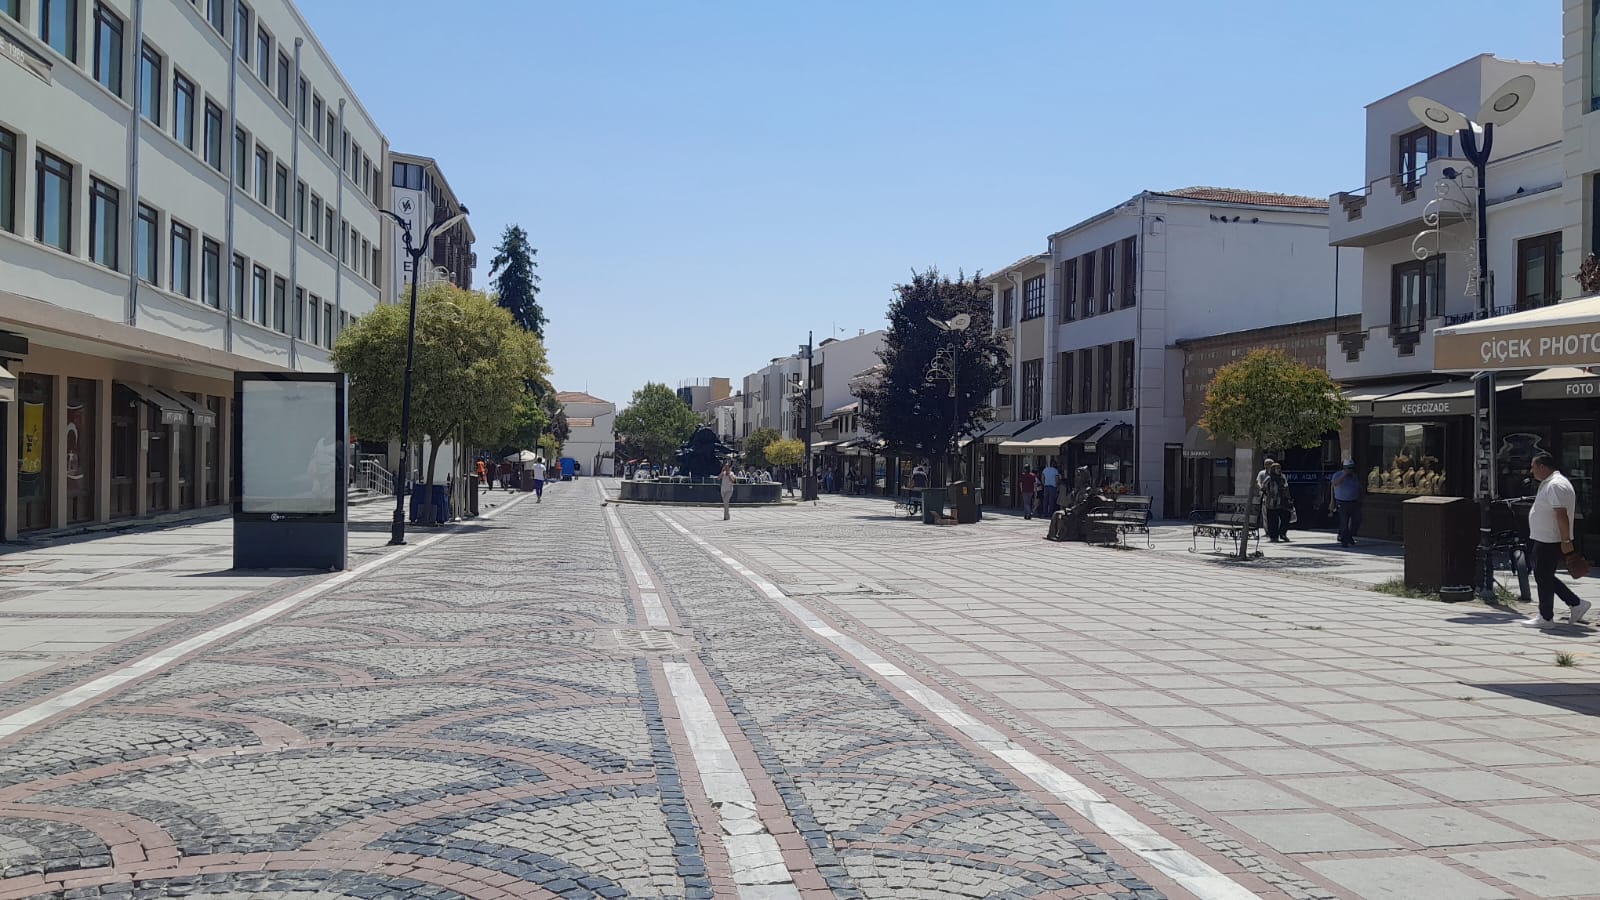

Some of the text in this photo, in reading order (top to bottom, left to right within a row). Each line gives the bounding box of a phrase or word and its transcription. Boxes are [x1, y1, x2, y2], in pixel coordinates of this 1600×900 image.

[1480, 336, 1532, 363] ÇİÇEK
[1566, 383, 1594, 395] FOTO
[1401, 401, 1450, 415] KEÇECİZADE
